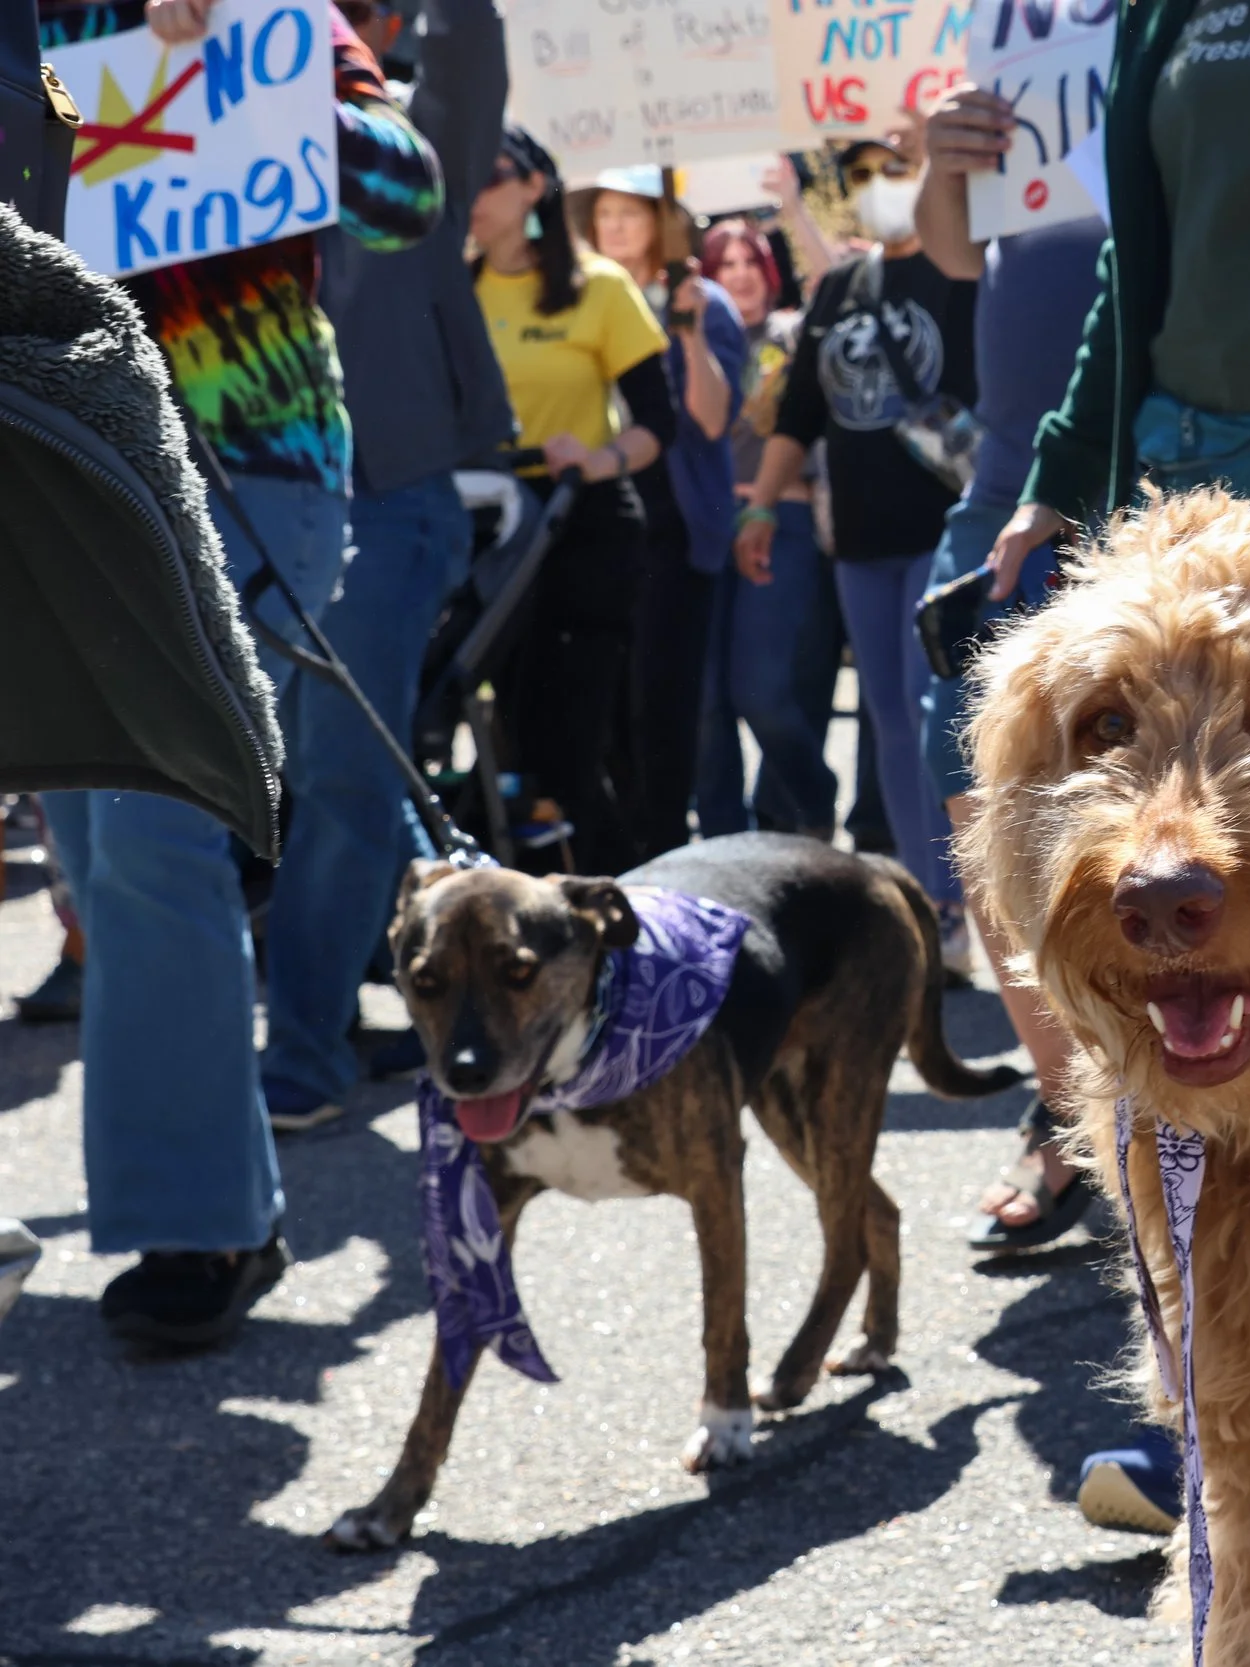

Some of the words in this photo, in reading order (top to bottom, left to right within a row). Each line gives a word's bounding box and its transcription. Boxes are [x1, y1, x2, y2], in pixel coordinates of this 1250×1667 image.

[204, 8, 313, 125] NO
[820, 11, 911, 64] NOT
[803, 75, 870, 124] US
[113, 136, 328, 271] Kings
